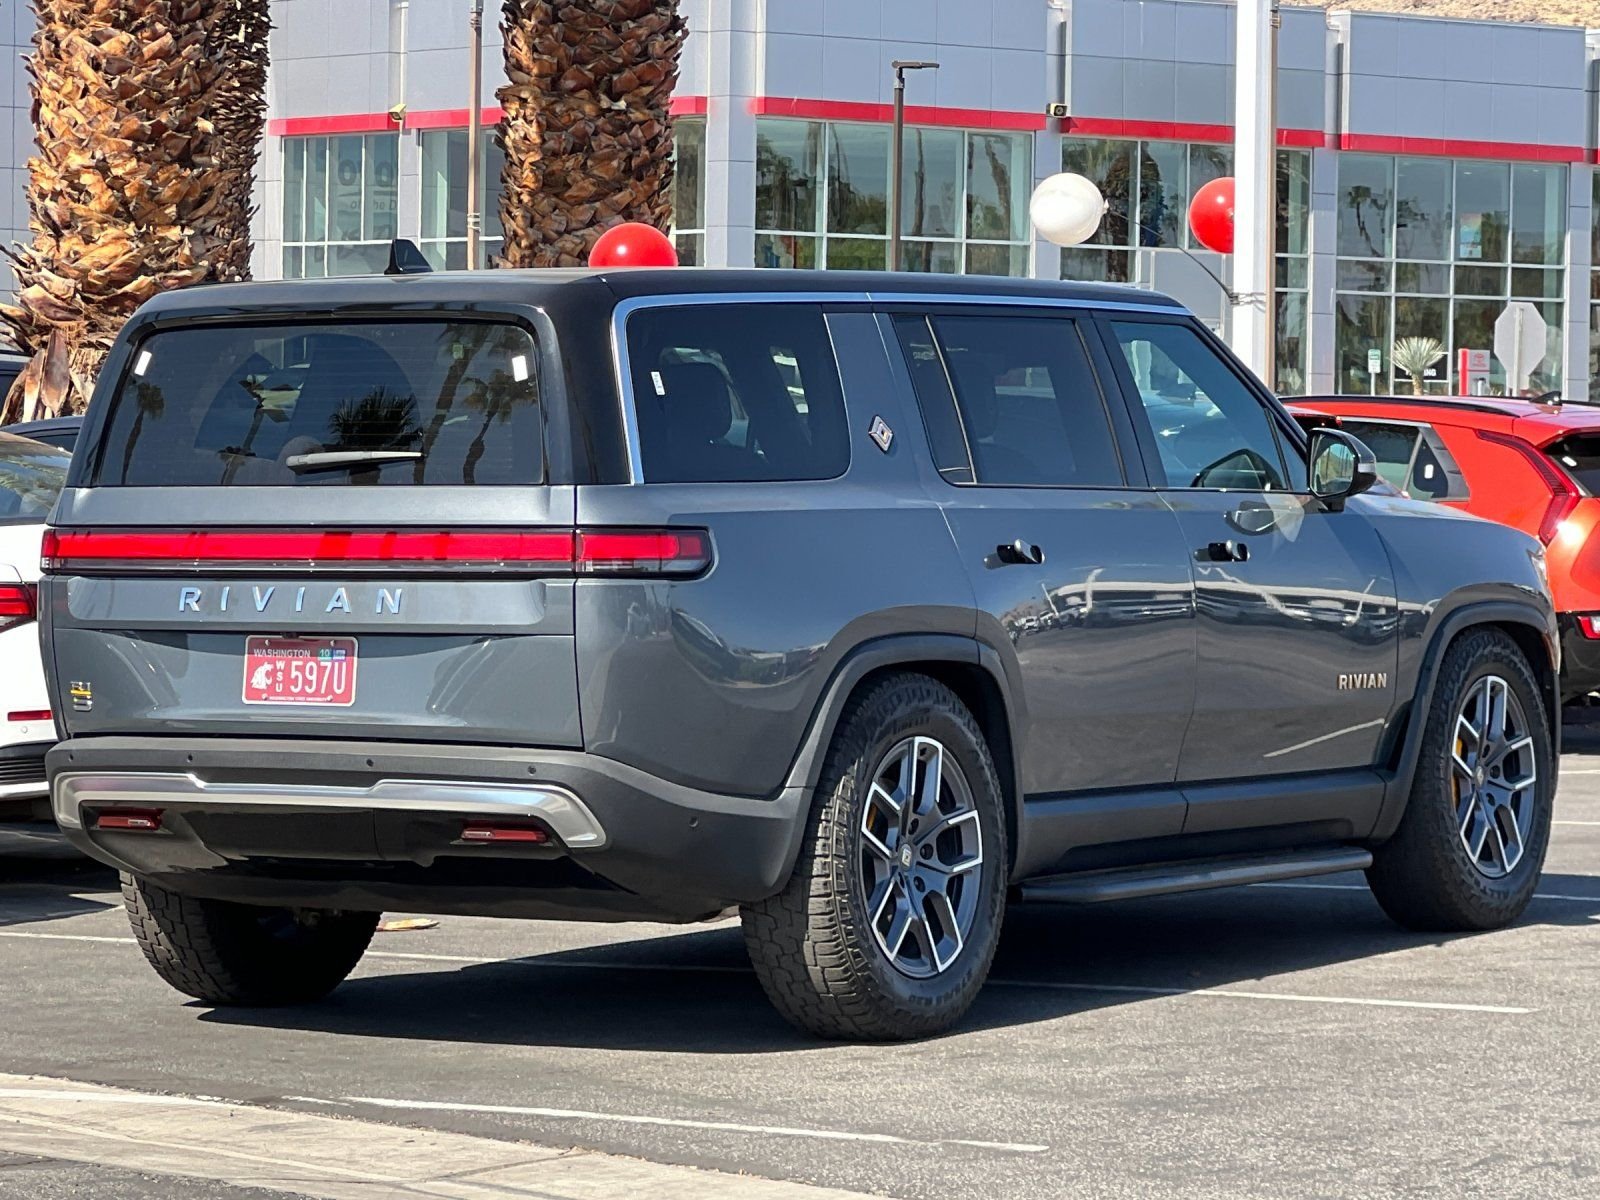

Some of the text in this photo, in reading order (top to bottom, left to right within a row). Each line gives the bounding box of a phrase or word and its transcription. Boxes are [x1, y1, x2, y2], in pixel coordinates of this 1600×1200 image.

[178, 586, 402, 614] RIVIAN
[253, 648, 311, 658] WASHINGTON
[289, 661, 347, 694] 597U
[1337, 672, 1387, 690] RIVIAN
